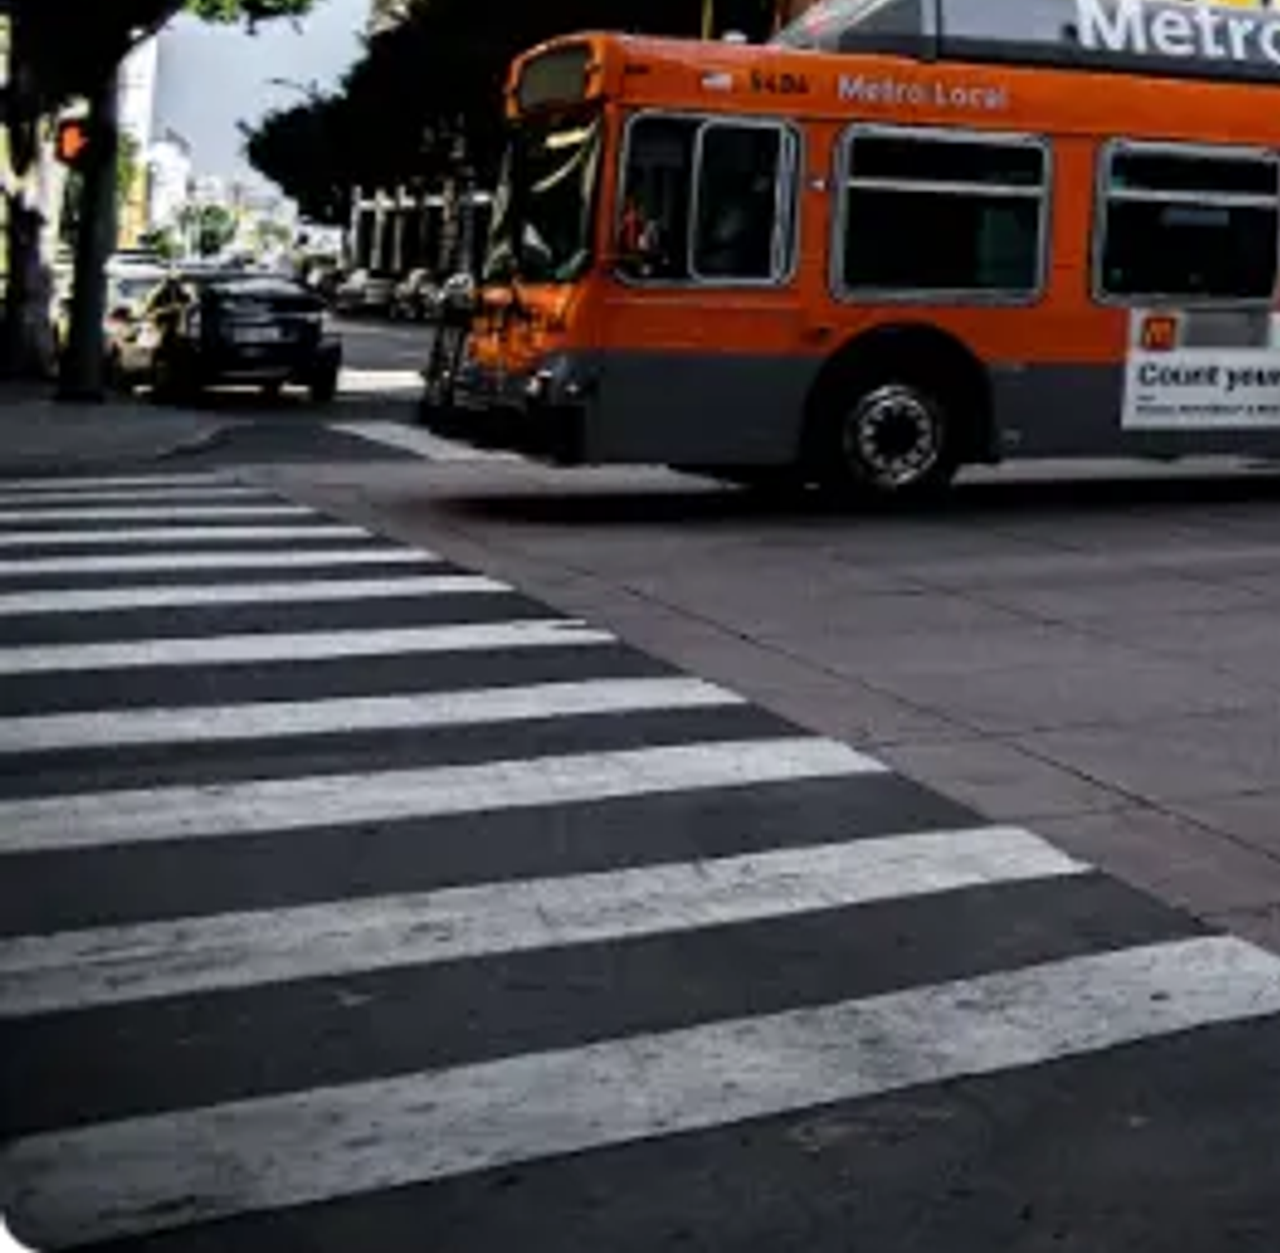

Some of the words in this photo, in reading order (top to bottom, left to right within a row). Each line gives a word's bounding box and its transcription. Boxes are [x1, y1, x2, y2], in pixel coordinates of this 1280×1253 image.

[838, 74, 922, 103] Metro
[935, 80, 1008, 109] Local
[1139, 362, 1219, 387] Count
